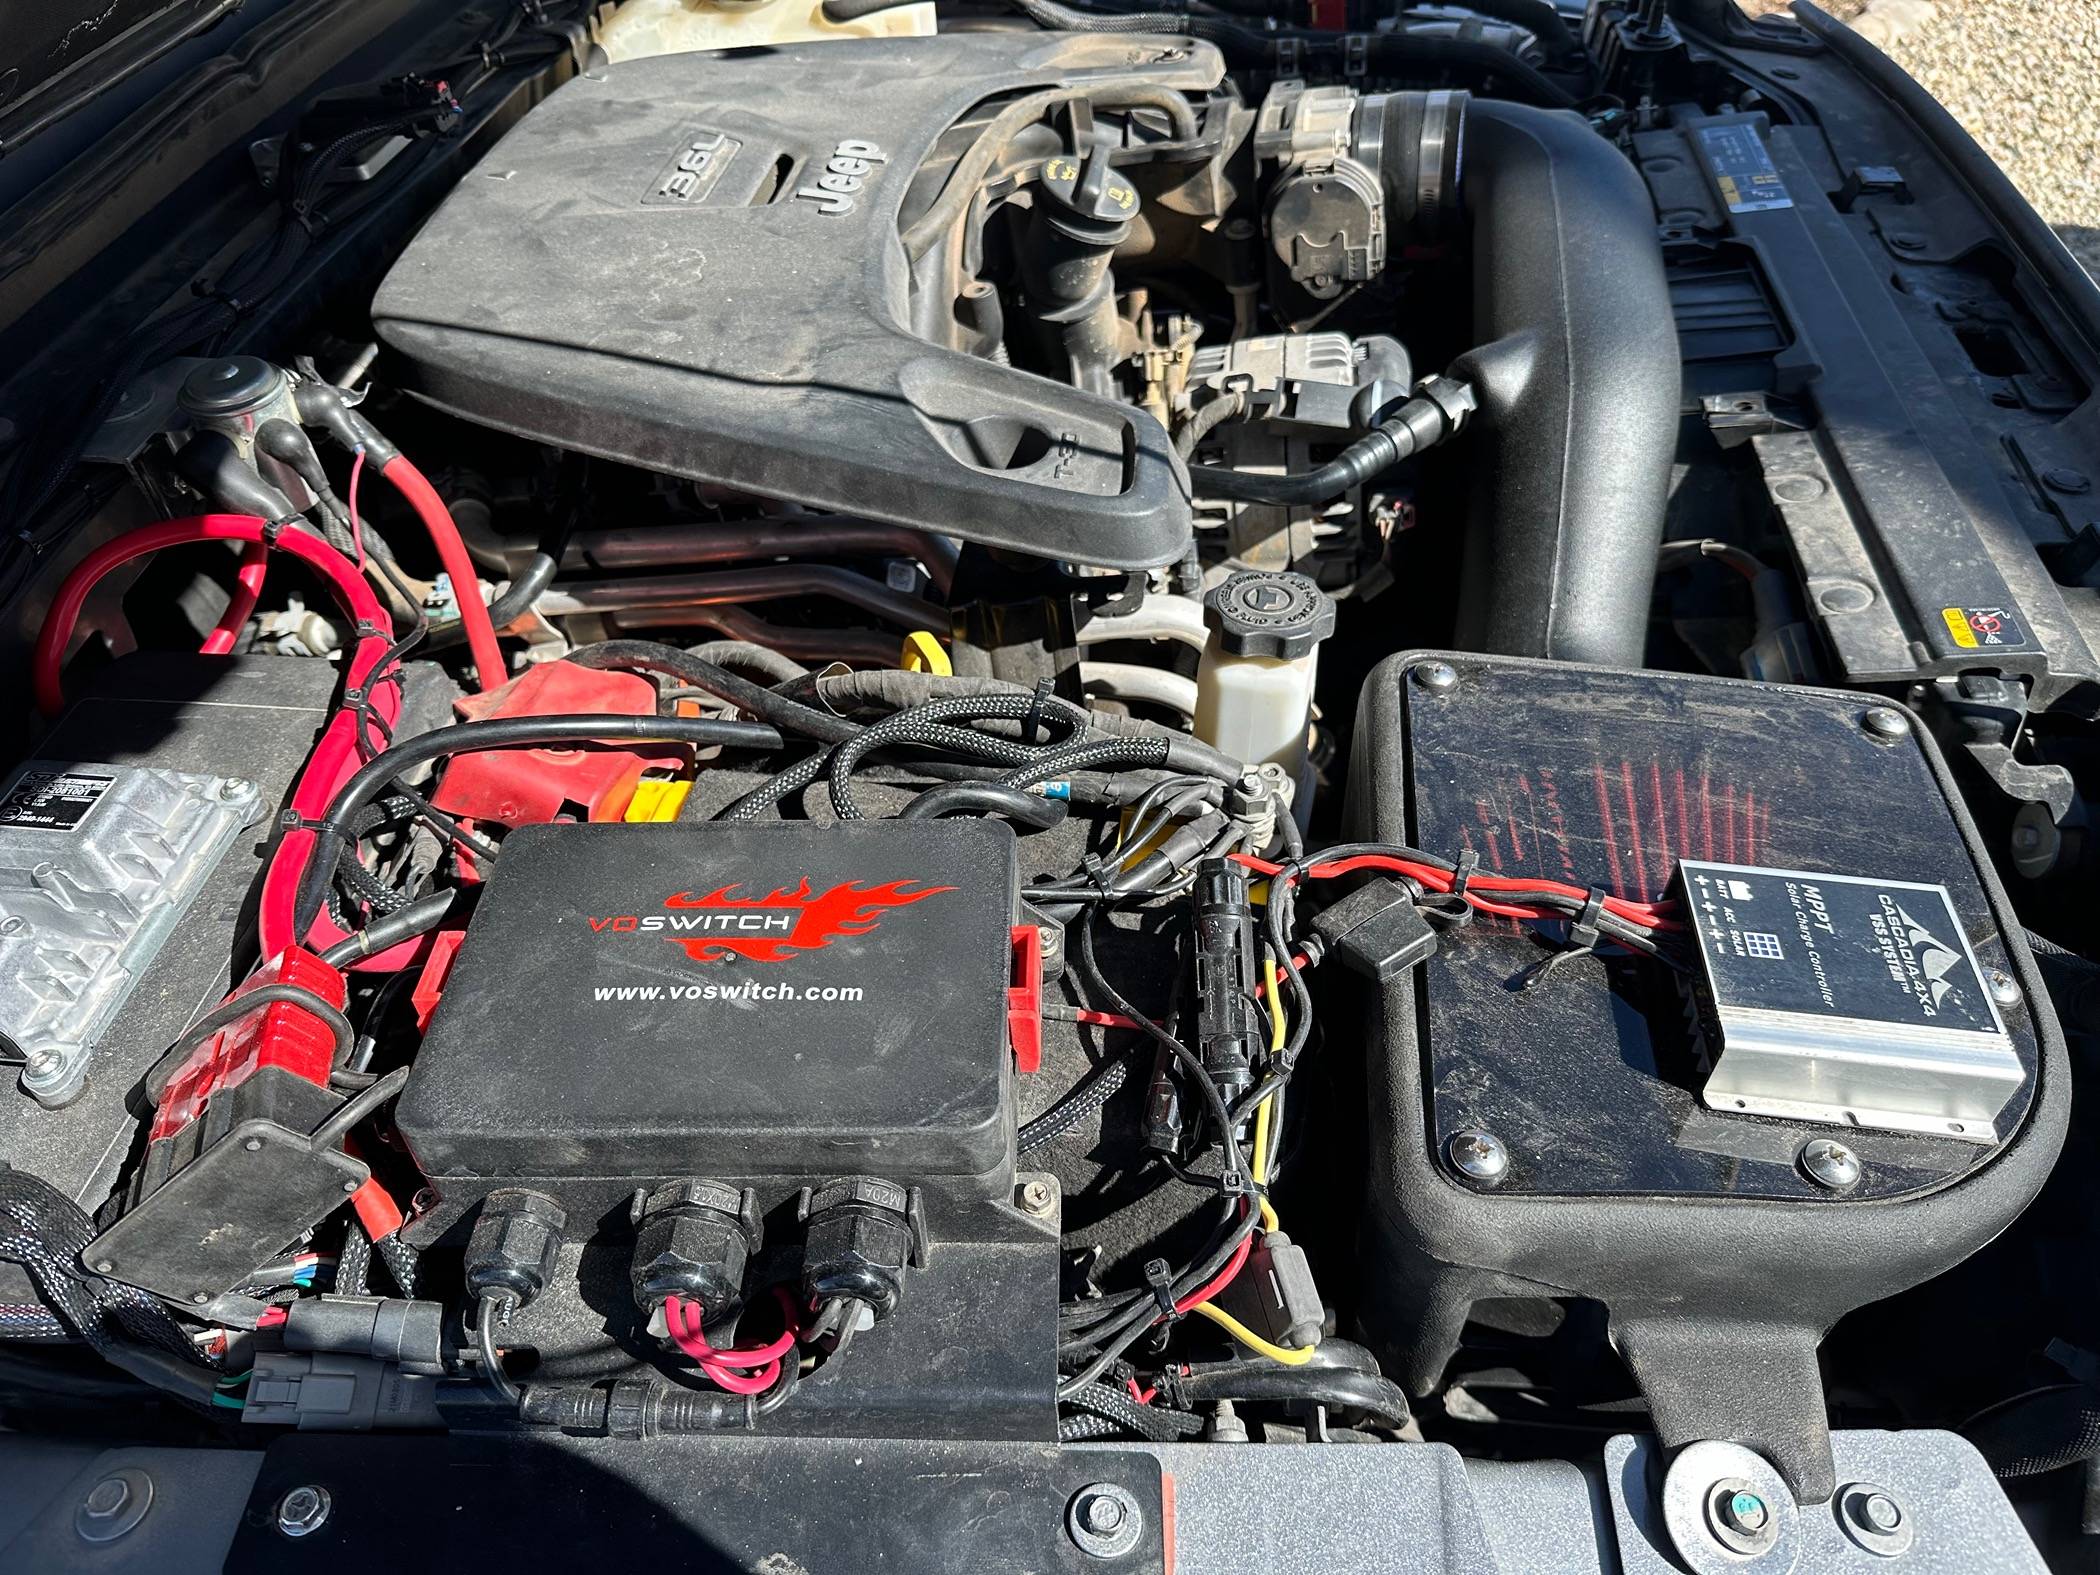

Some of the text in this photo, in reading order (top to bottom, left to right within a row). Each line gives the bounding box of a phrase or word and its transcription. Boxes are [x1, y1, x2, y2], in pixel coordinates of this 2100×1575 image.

[795, 138, 888, 217] Jeep
[588, 915, 790, 932] VOSWITCH
[1714, 878, 1747, 957] BATT ACC SOLAR
[1800, 883, 1835, 936] MPPT
[1869, 913, 1889, 936] VSS
[1785, 881, 1835, 1008] Solar Charge Controller
[1878, 894, 1937, 1017] CASCADIA 4X4
[594, 982, 863, 1001] www.voswitch.com
